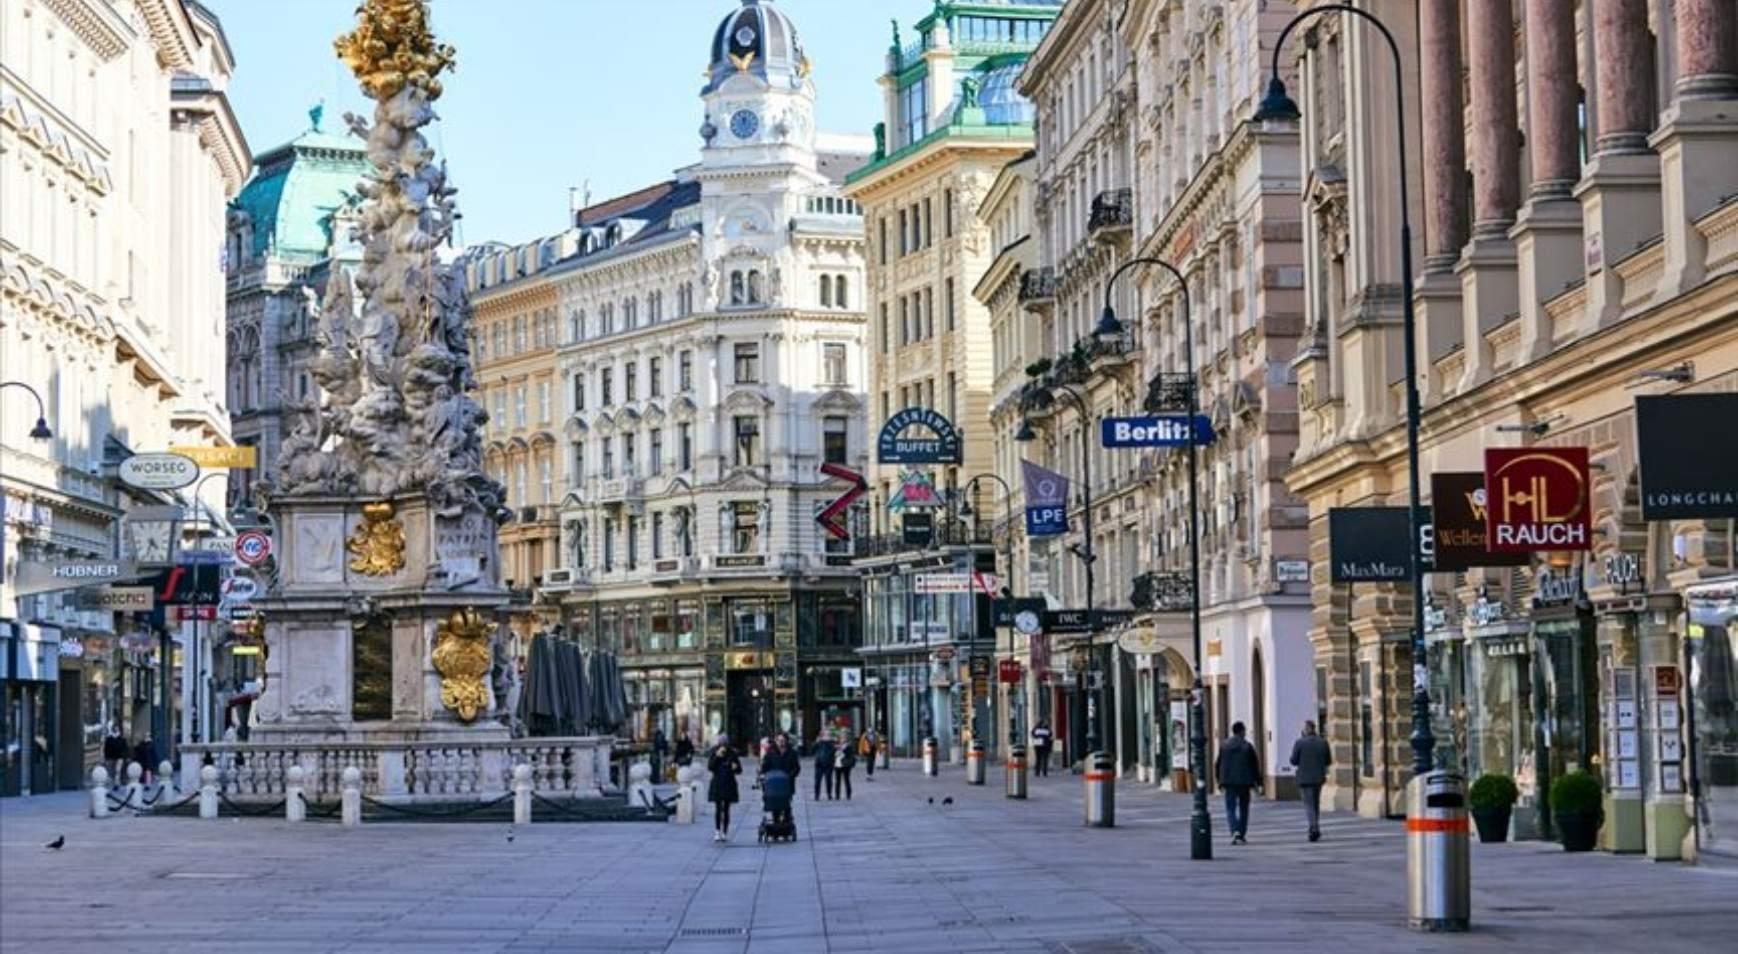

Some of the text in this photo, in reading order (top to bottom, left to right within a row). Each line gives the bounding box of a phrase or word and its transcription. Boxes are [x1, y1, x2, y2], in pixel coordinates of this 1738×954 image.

[896, 442, 941, 452] BUFFET
[130, 462, 186, 473] WORSEG
[1648, 492, 1738, 506] LONGCHA
[1032, 508, 1063, 523] LPE
[1497, 524, 1584, 544] RAUCH
[1341, 562, 1404, 576] MaxMara
